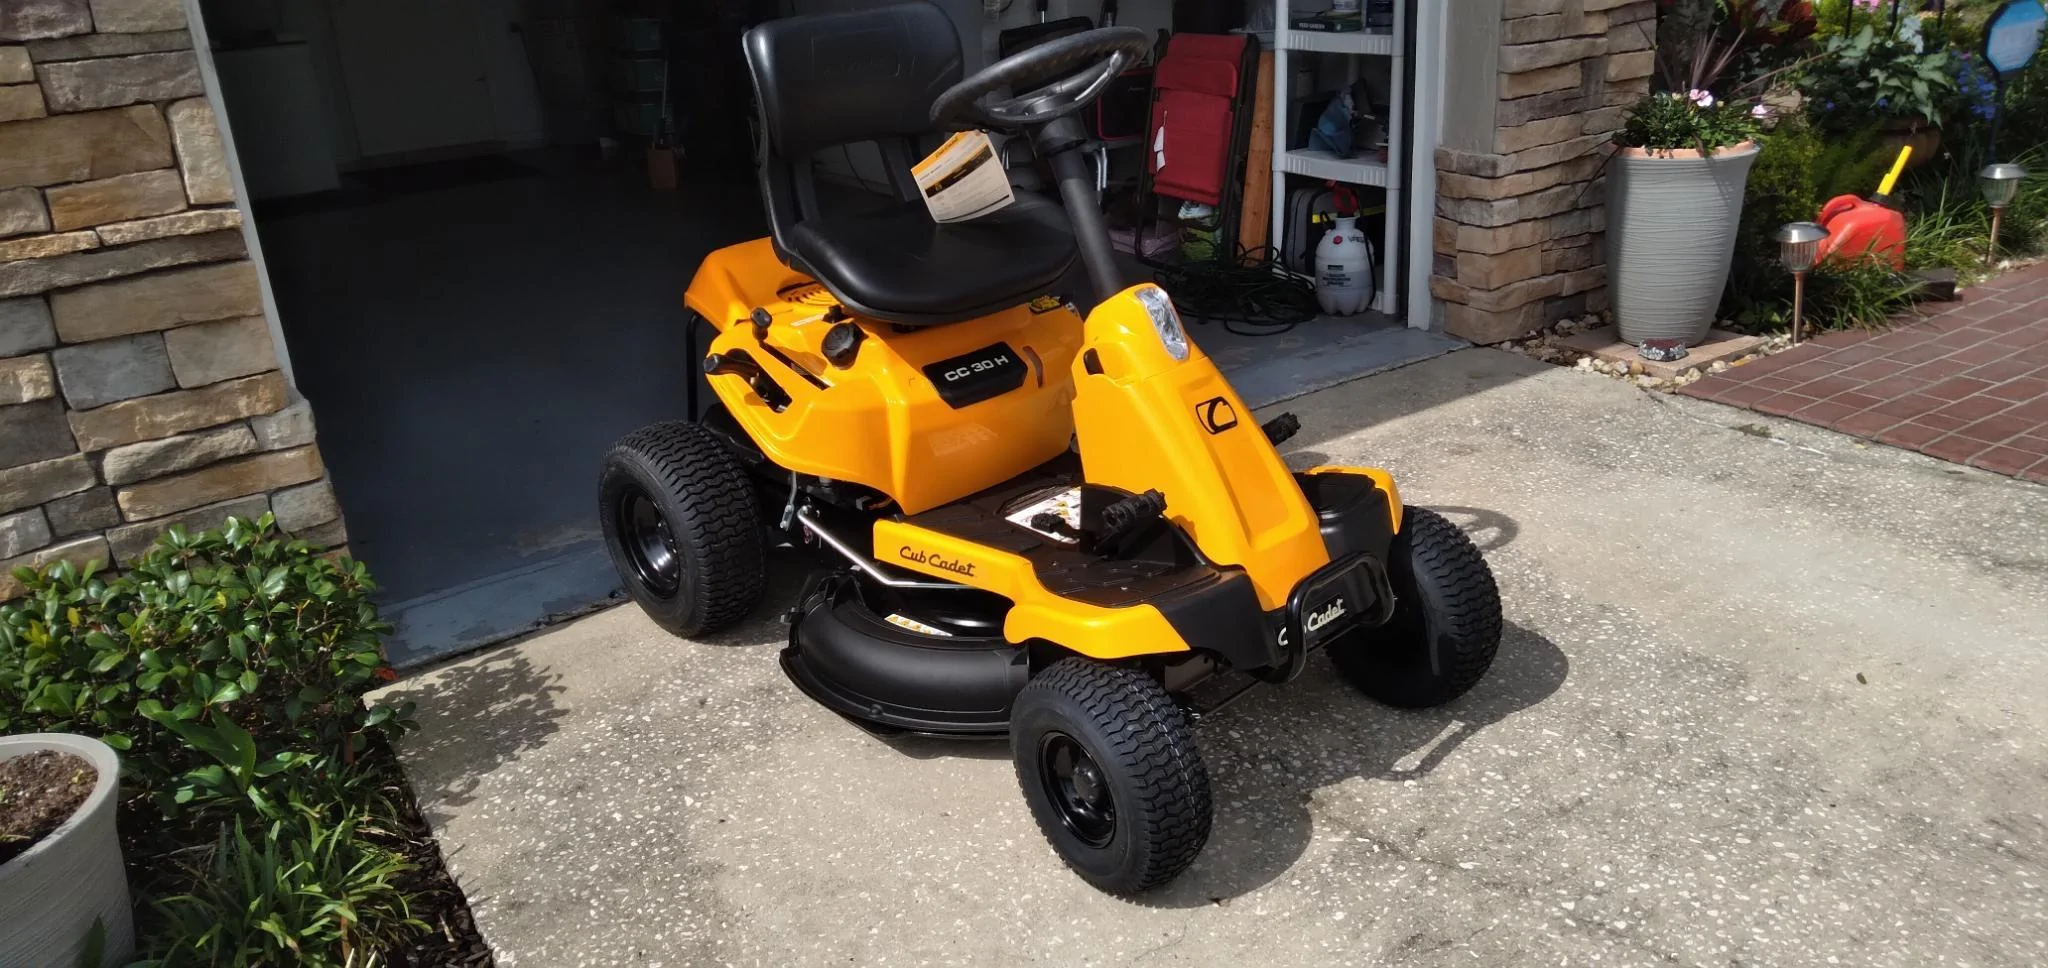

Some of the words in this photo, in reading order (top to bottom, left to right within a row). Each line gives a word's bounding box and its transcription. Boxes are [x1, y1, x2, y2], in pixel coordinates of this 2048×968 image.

[944, 367, 970, 381] CC
[971, 360, 994, 372] 30
[994, 355, 1009, 366] H
[900, 545, 927, 564] Cub
[928, 554, 976, 577] Cadet
[1307, 598, 1345, 632] Cadet
